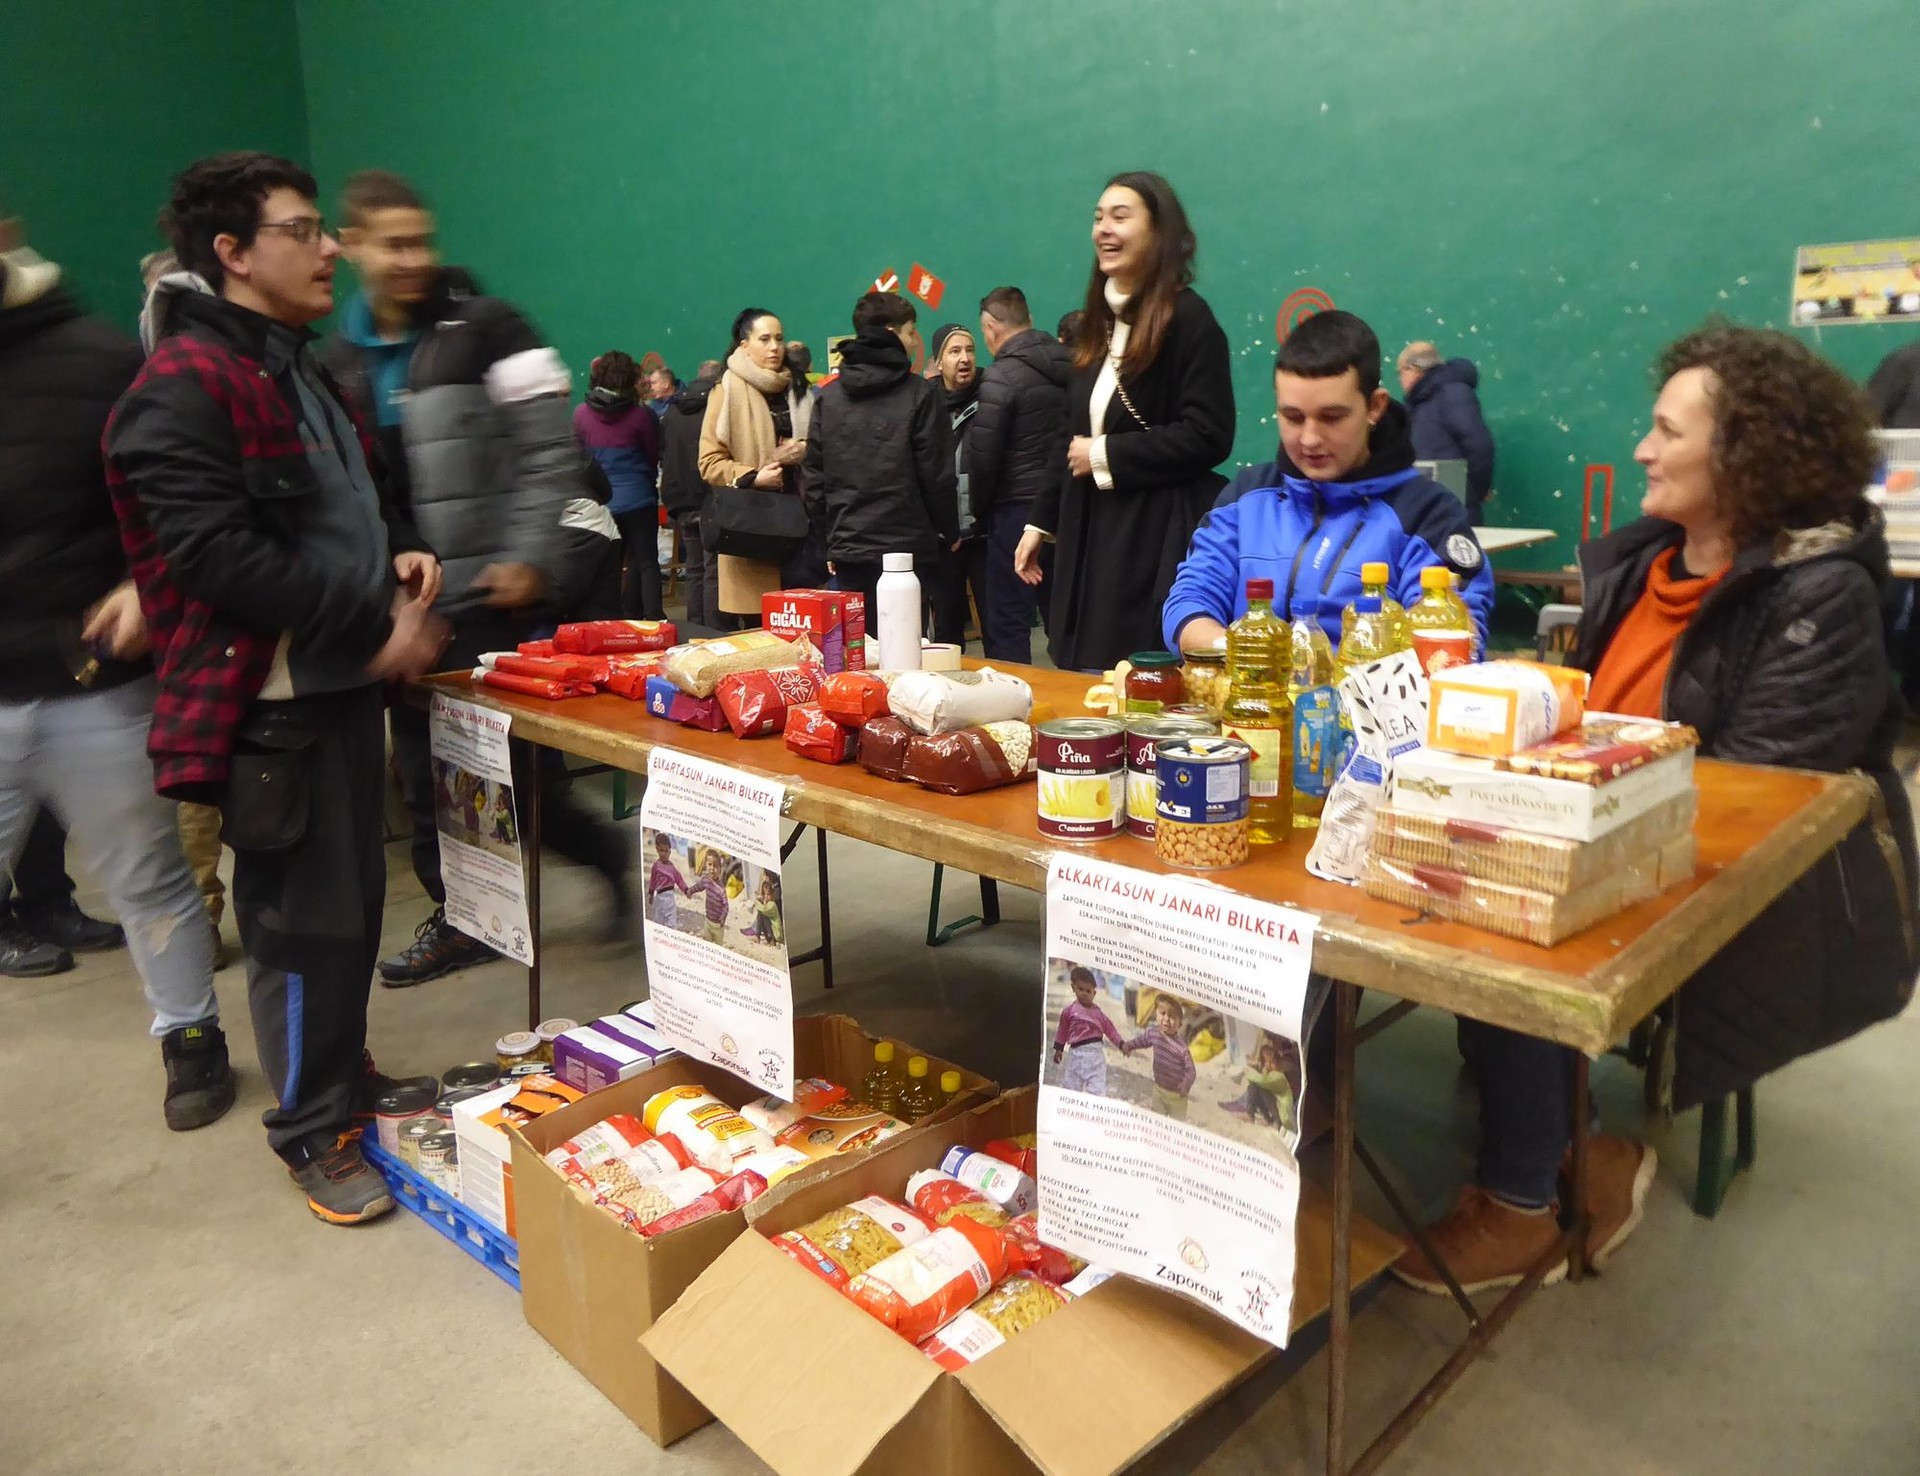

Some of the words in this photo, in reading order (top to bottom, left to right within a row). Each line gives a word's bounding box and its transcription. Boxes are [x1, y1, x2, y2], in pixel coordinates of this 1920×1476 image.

[769, 612, 812, 629] CIGALA
[783, 602, 797, 614] LA
[1057, 741, 1091, 763] Piña
[653, 757, 703, 781] ELKARTASUN
[704, 773, 736, 795] JANARI
[738, 785, 774, 808] BILKETA
[1058, 867, 1155, 904] ELKARTASUN
[1159, 893, 1221, 922] JANARI
[1228, 910, 1299, 944] BILKETA
[1062, 894, 1094, 909] ZAPOREAK
[1095, 902, 1128, 919] EUROPARA
[1131, 911, 1153, 926] IRISTEN
[1155, 920, 1175, 932] DIREN
[1231, 943, 1257, 956] JANARI
[1259, 951, 1283, 963] DUINA
[1059, 935, 1095, 951] PRESTATZEN
[1097, 946, 1113, 957] DUTE
[1115, 950, 1158, 972] HARRAPATUTA
[1160, 966, 1186, 981] DAUDEN
[1188, 976, 1222, 995] PERTSONA
[1079, 910, 1115, 926] ESKAINTZEN
[1159, 933, 1177, 946] ASMO
[1179, 941, 1207, 955] GABEKO
[1209, 950, 1243, 966] ELKARTEA
[1090, 934, 1117, 946] GREZIAN
[1120, 942, 1144, 954] DAUDEN
[1236, 982, 1266, 998] JANARIA
[710, 1052, 751, 1077] Zaporeak
[1053, 1140, 1087, 1154] HERRITAR
[1089, 1148, 1121, 1162] GUZTIAK
[1123, 1157, 1153, 1169] DEITZEN
[1182, 1176, 1234, 1203] URTARRILAREN
[1057, 1107, 1110, 1125] URTARRILAREN
[1173, 1139, 1198, 1152] JANARI
[1200, 1148, 1226, 1164] BILKETA
[1255, 1170, 1268, 1181] ETA
[1104, 1129, 1138, 1142] GOIZEAN
[1182, 1153, 1209, 1168] BILKETA
[1140, 1115, 1152, 1124] ETA
[1244, 1154, 1273, 1172] JARRIKO
[1095, 1161, 1128, 1176] PLAZARA
[1186, 1190, 1210, 1204] JANARI
[1254, 1219, 1274, 1234] PARTE
[1045, 1228, 1067, 1243] OLIOA
[1156, 1263, 1223, 1305] Zaporeak
